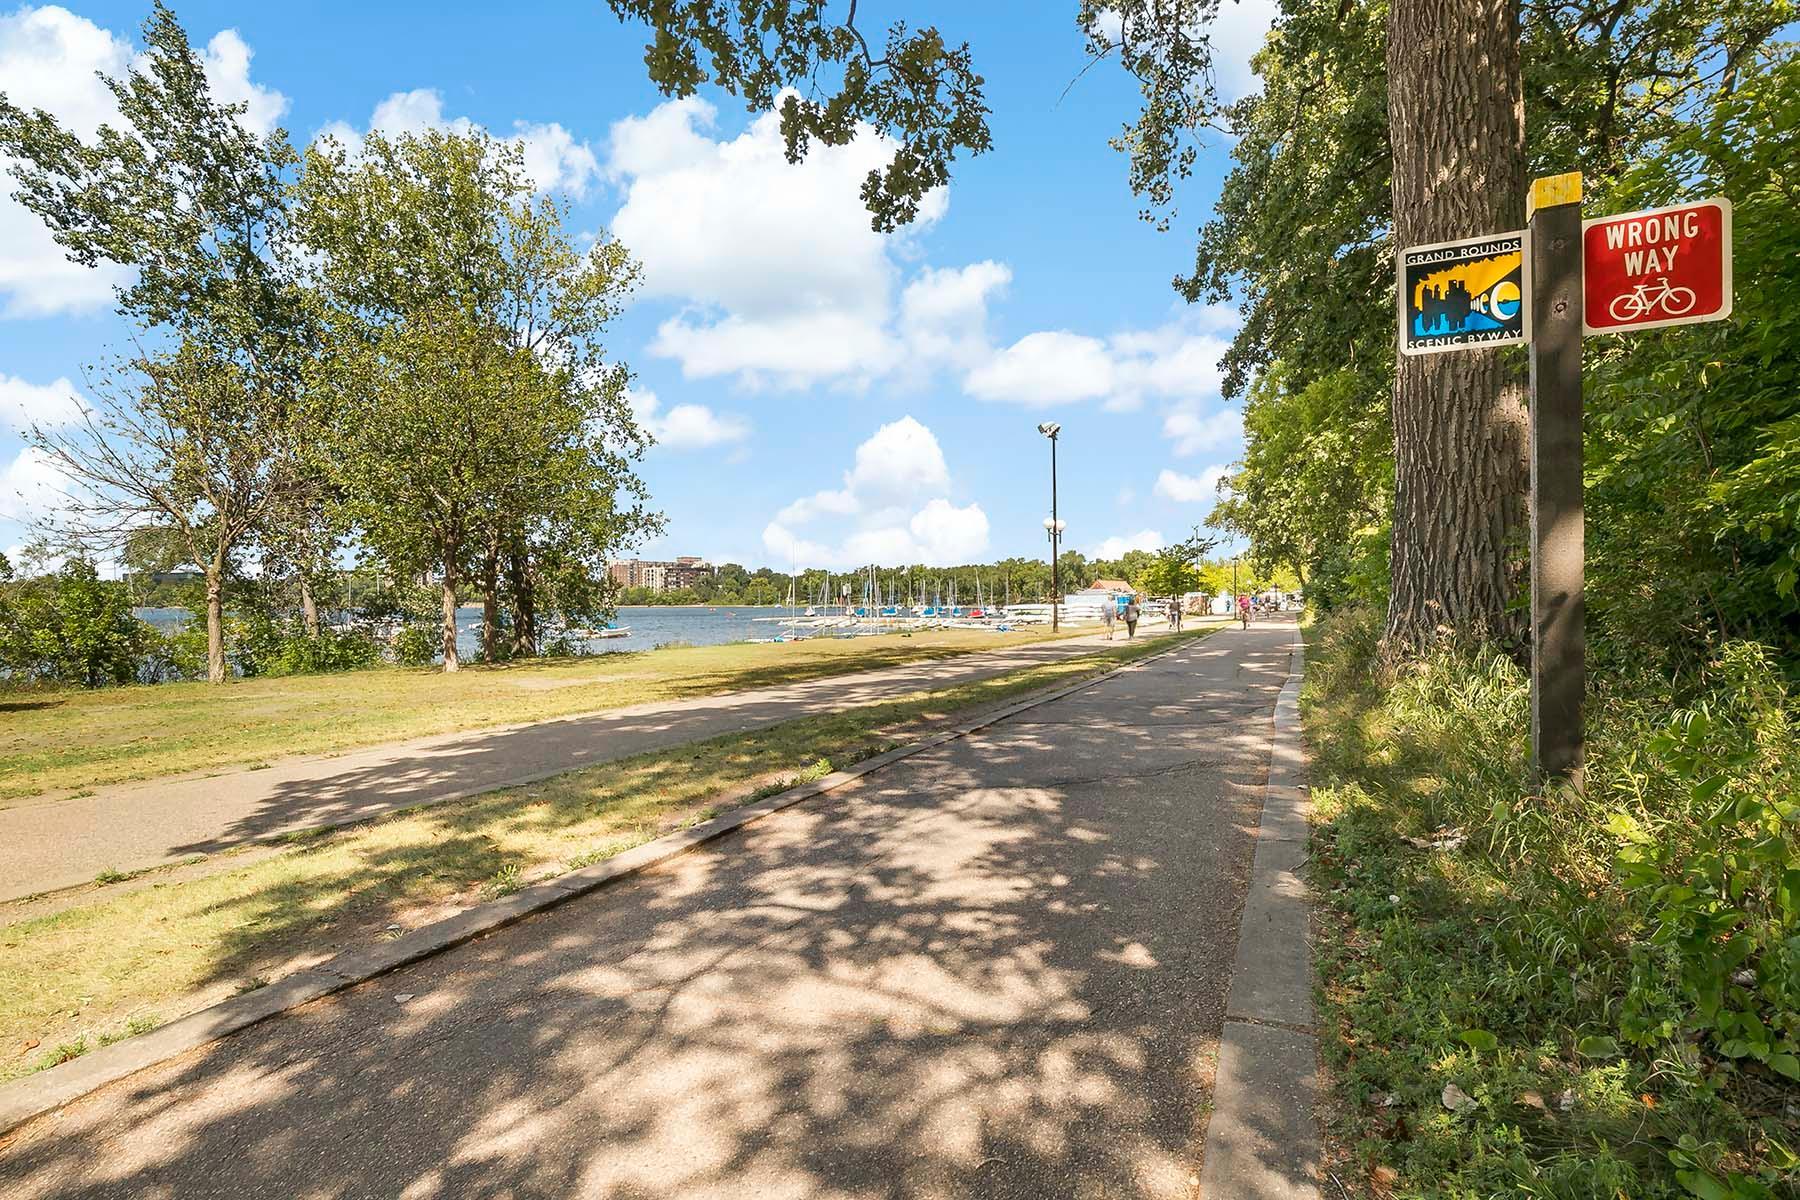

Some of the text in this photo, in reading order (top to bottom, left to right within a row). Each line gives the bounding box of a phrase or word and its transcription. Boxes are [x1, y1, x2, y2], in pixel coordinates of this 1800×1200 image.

[1606, 212, 1699, 250] WRONG
[1407, 239, 1520, 264] GRAND ROUNDS
[1624, 245, 1680, 277] WAY
[1407, 328, 1521, 349] SCENIC BYWAY
